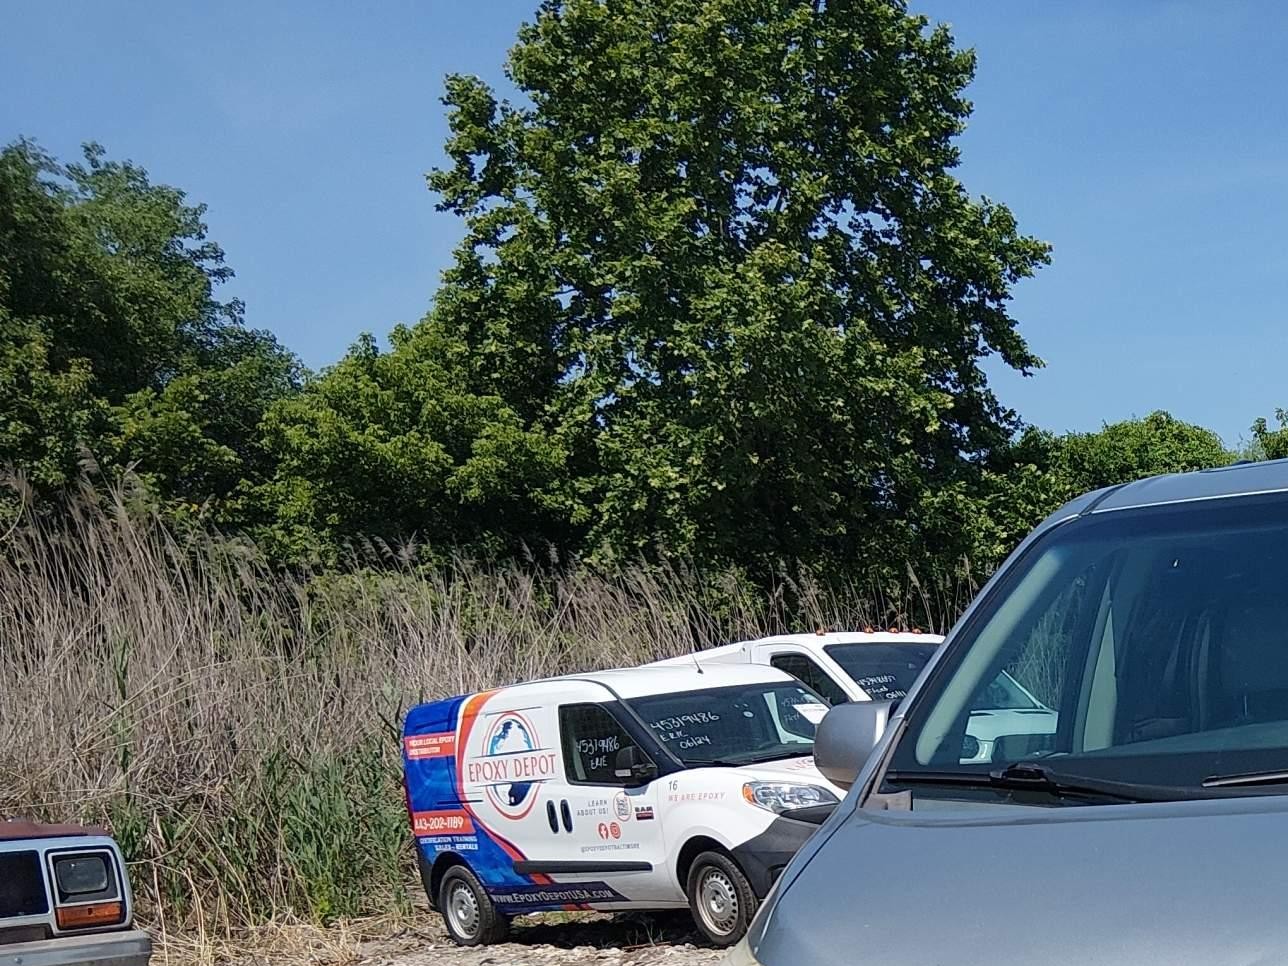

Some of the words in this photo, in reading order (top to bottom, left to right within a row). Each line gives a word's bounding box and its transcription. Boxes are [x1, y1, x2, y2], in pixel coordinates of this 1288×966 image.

[650, 711, 720, 731] 45319486
[575, 736, 619, 754] 45319486
[468, 759, 508, 782] EPOXY
[513, 753, 556, 778] DEPOT
[668, 780, 678, 791] 16
[681, 793, 695, 801] ARE
[698, 792, 725, 801] EPOXY
[588, 799, 608, 807] LEARN
[577, 808, 597, 817] ABOUT
[599, 807, 609, 815] US!
